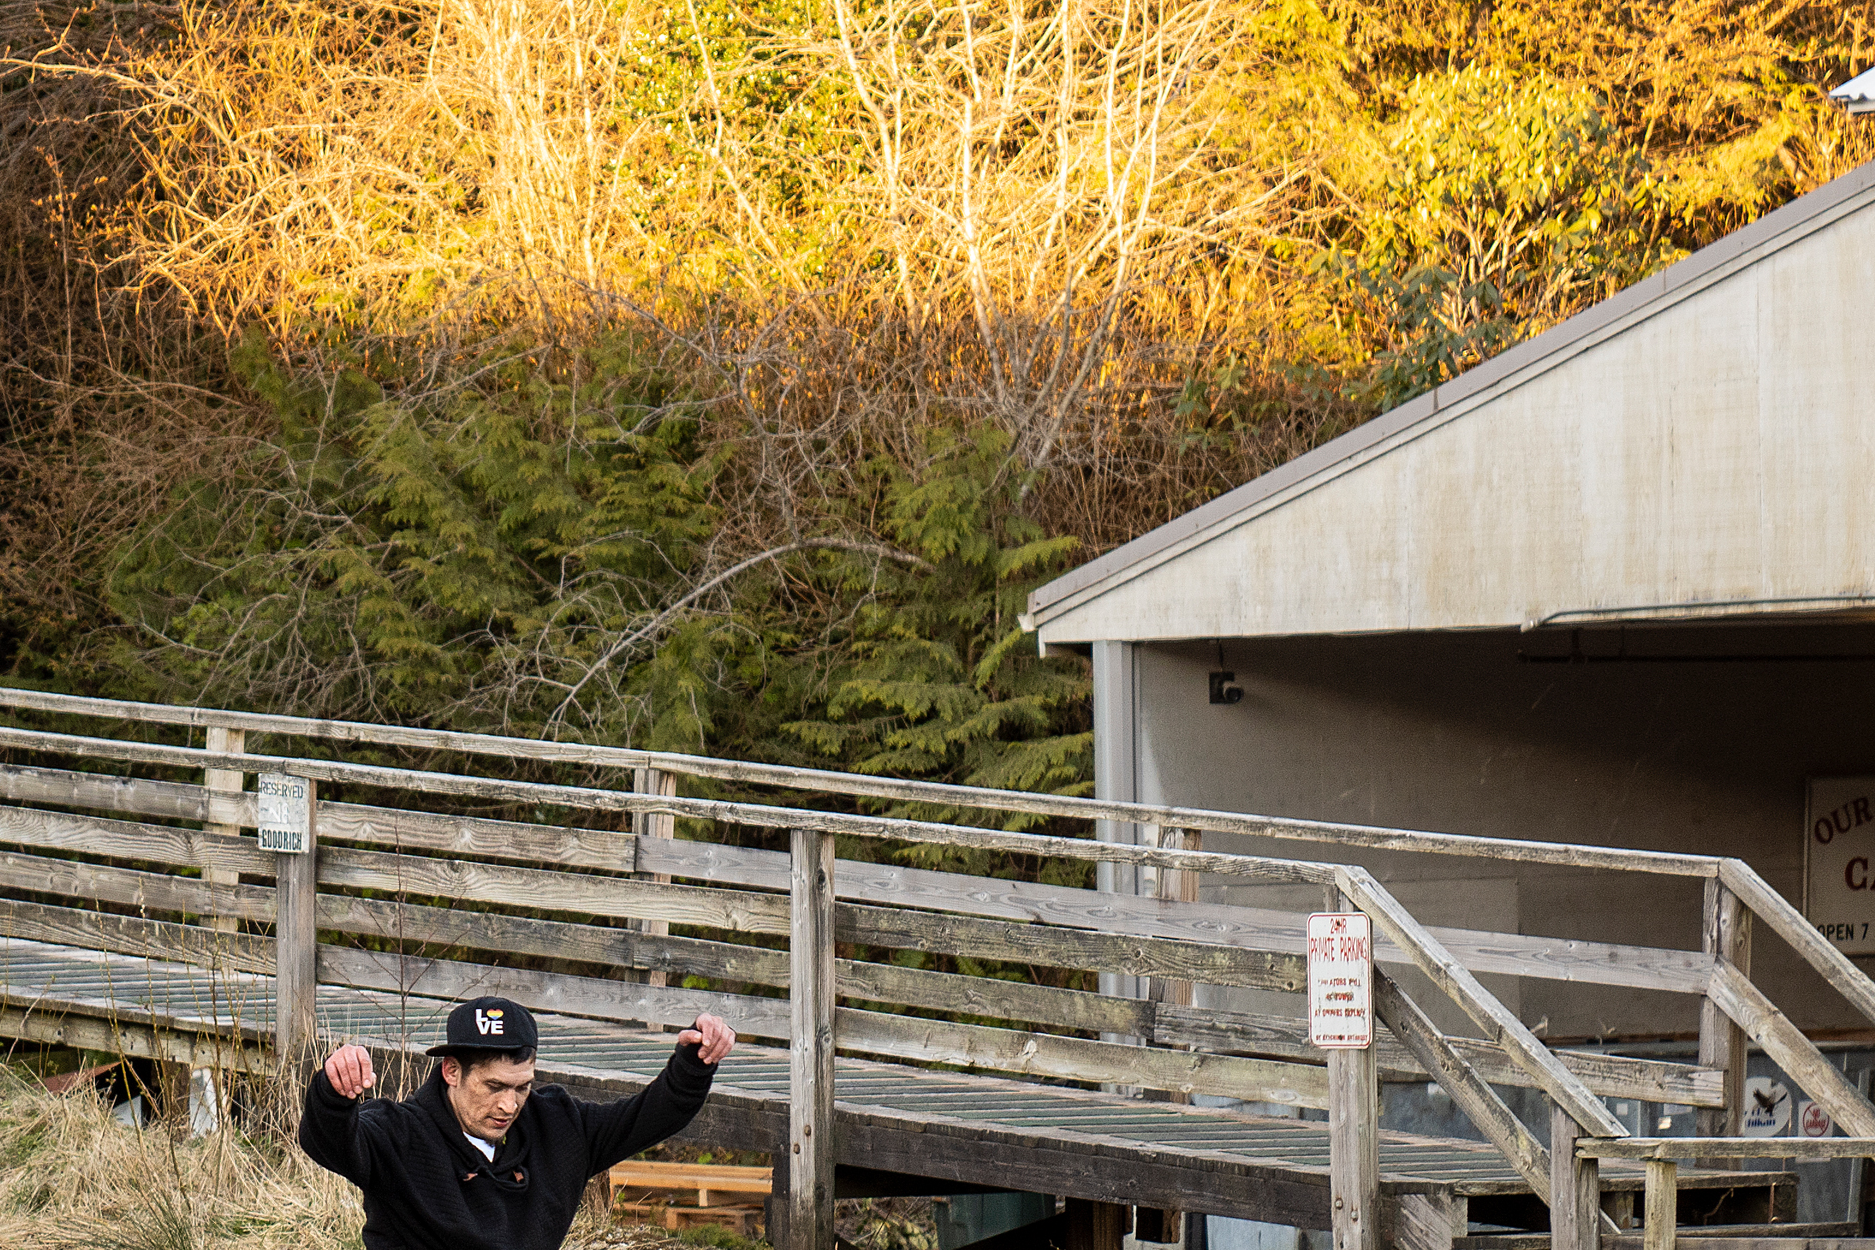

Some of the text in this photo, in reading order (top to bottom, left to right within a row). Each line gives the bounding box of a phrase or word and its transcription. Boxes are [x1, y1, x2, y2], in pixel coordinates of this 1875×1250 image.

[260, 781, 304, 799] RESERVED
[1814, 797, 1874, 845] OUR
[262, 829, 302, 851] GOODRICH
[1845, 857, 1875, 891] C
[1816, 924, 1869, 941] OPEN 7
[1310, 936, 1368, 962] PRIVATE PARKING
